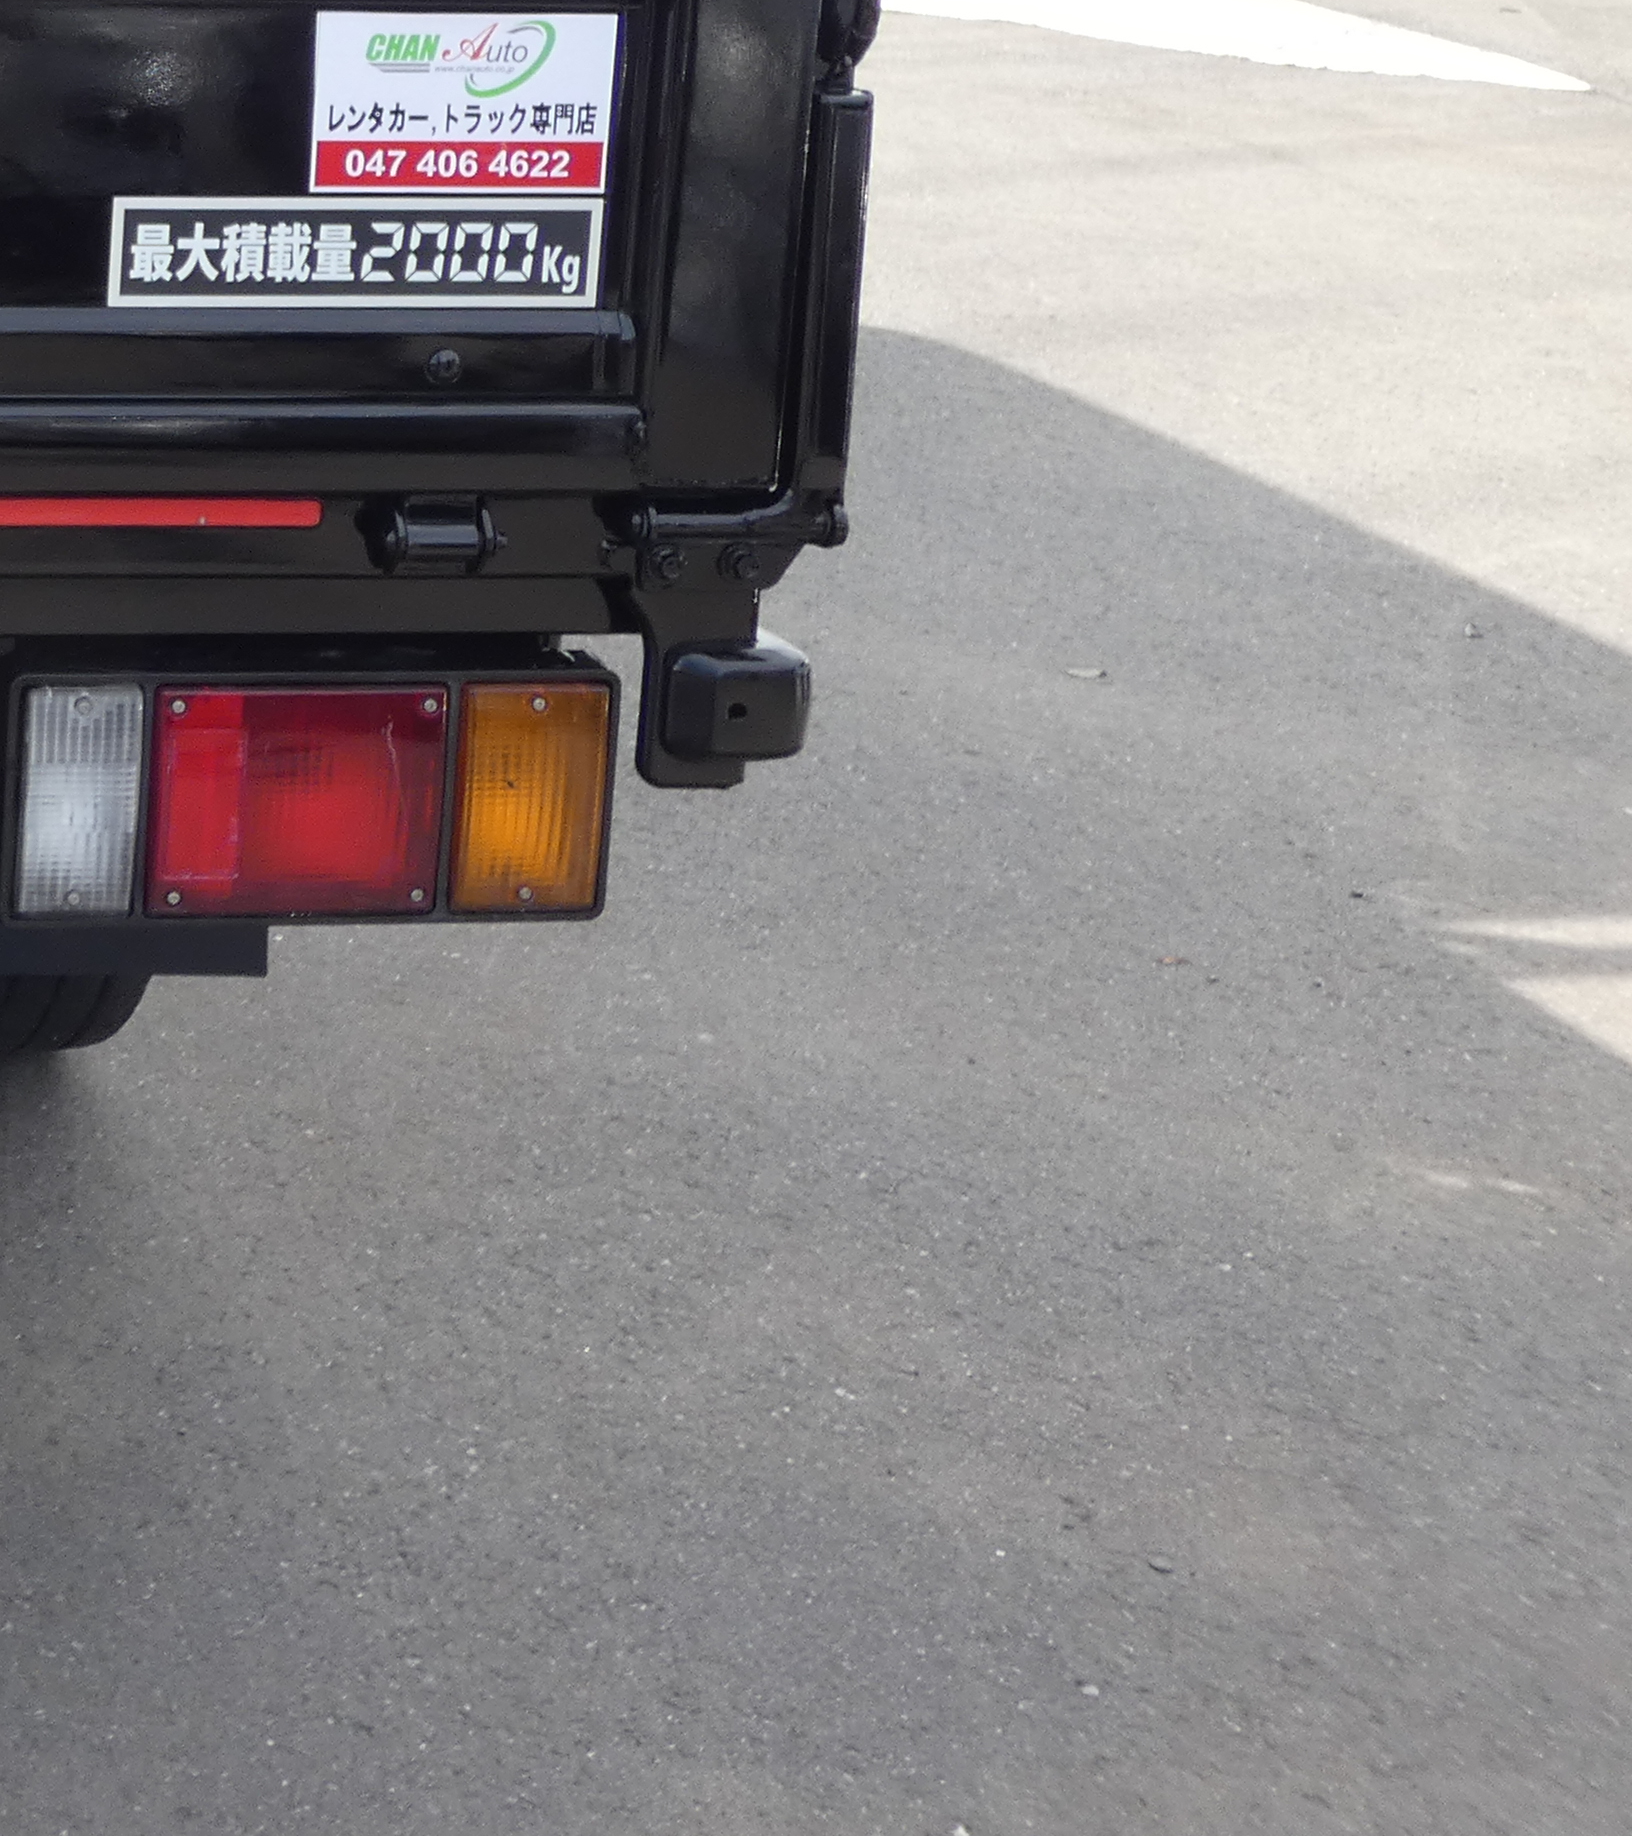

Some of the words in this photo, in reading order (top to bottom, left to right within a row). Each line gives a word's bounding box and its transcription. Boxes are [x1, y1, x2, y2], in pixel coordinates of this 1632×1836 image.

[366, 33, 441, 62] CHAN
[442, 22, 529, 62] Auto
[345, 150, 403, 178] 047
[417, 150, 479, 178] 406
[488, 150, 571, 179] 4622
